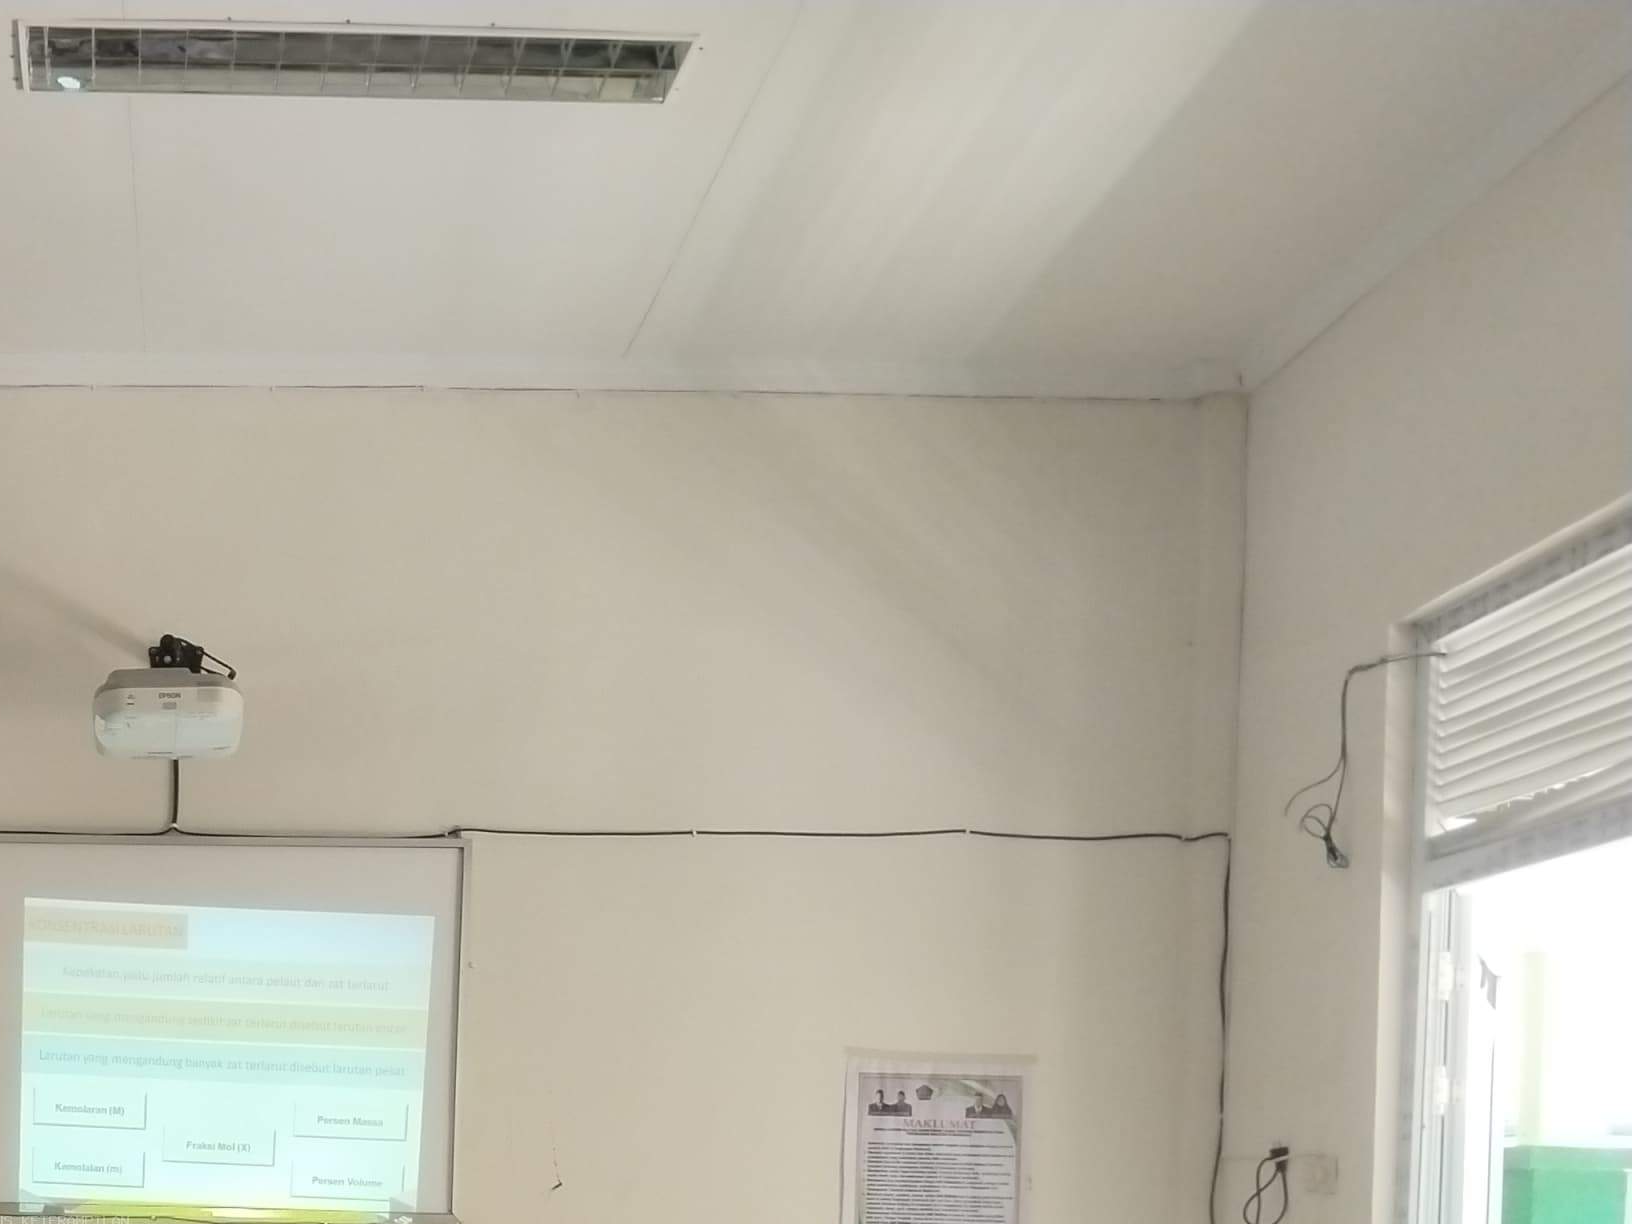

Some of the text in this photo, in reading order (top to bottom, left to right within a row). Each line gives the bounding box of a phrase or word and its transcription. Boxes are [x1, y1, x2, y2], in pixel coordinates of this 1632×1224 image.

[39, 1049, 80, 1063] Larutan
[83, 1053, 109, 1067] yang
[111, 1055, 183, 1070] mengandung
[185, 1057, 223, 1071] banyak
[226, 1061, 242, 1071] zat
[289, 1061, 331, 1074] disebut
[333, 1062, 372, 1076] larutan
[317, 1115, 351, 1126] Persen
[903, 1118, 977, 1130] MAKLUMAT
[186, 1140, 251, 1153] Fraksi Mol (X)
[311, 1175, 384, 1188] Persen Volume
